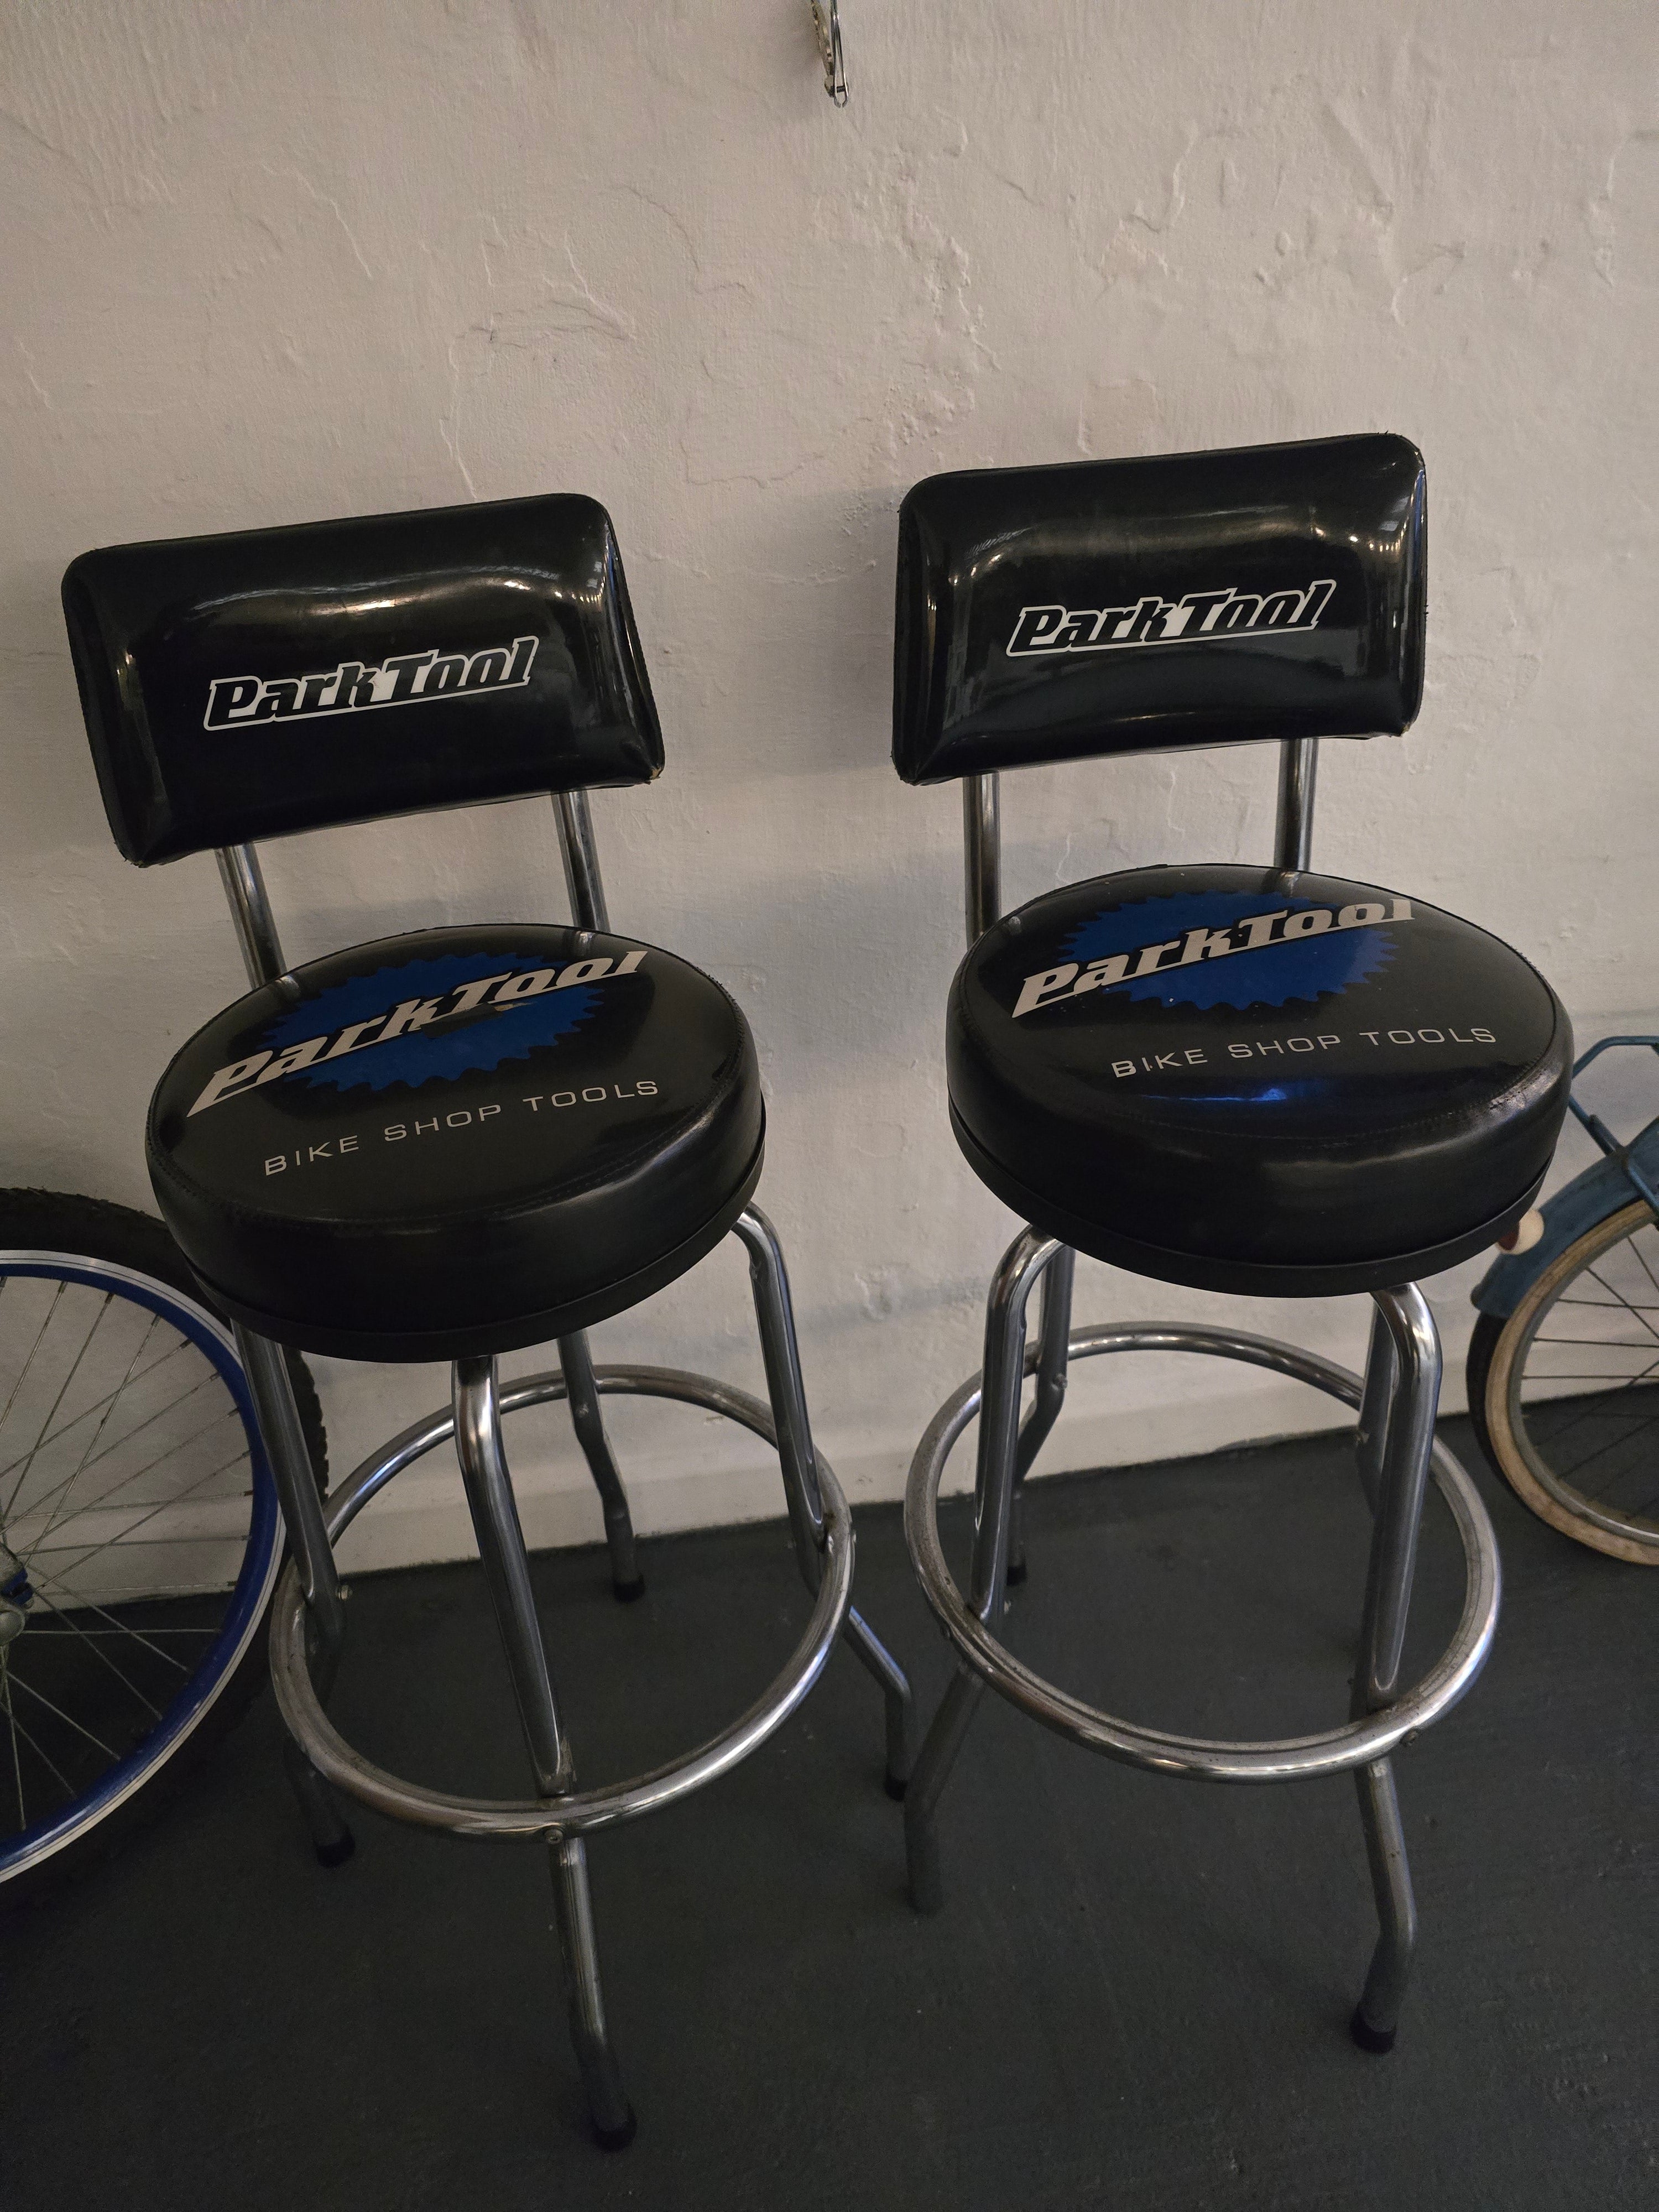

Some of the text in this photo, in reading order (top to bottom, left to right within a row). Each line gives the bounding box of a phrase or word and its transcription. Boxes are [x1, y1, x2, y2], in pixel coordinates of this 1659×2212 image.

[1111, 1027, 1496, 1078] BIKE SHOP TOOLS
[264, 1080, 658, 1176] BIKE SHOP TOOLS
